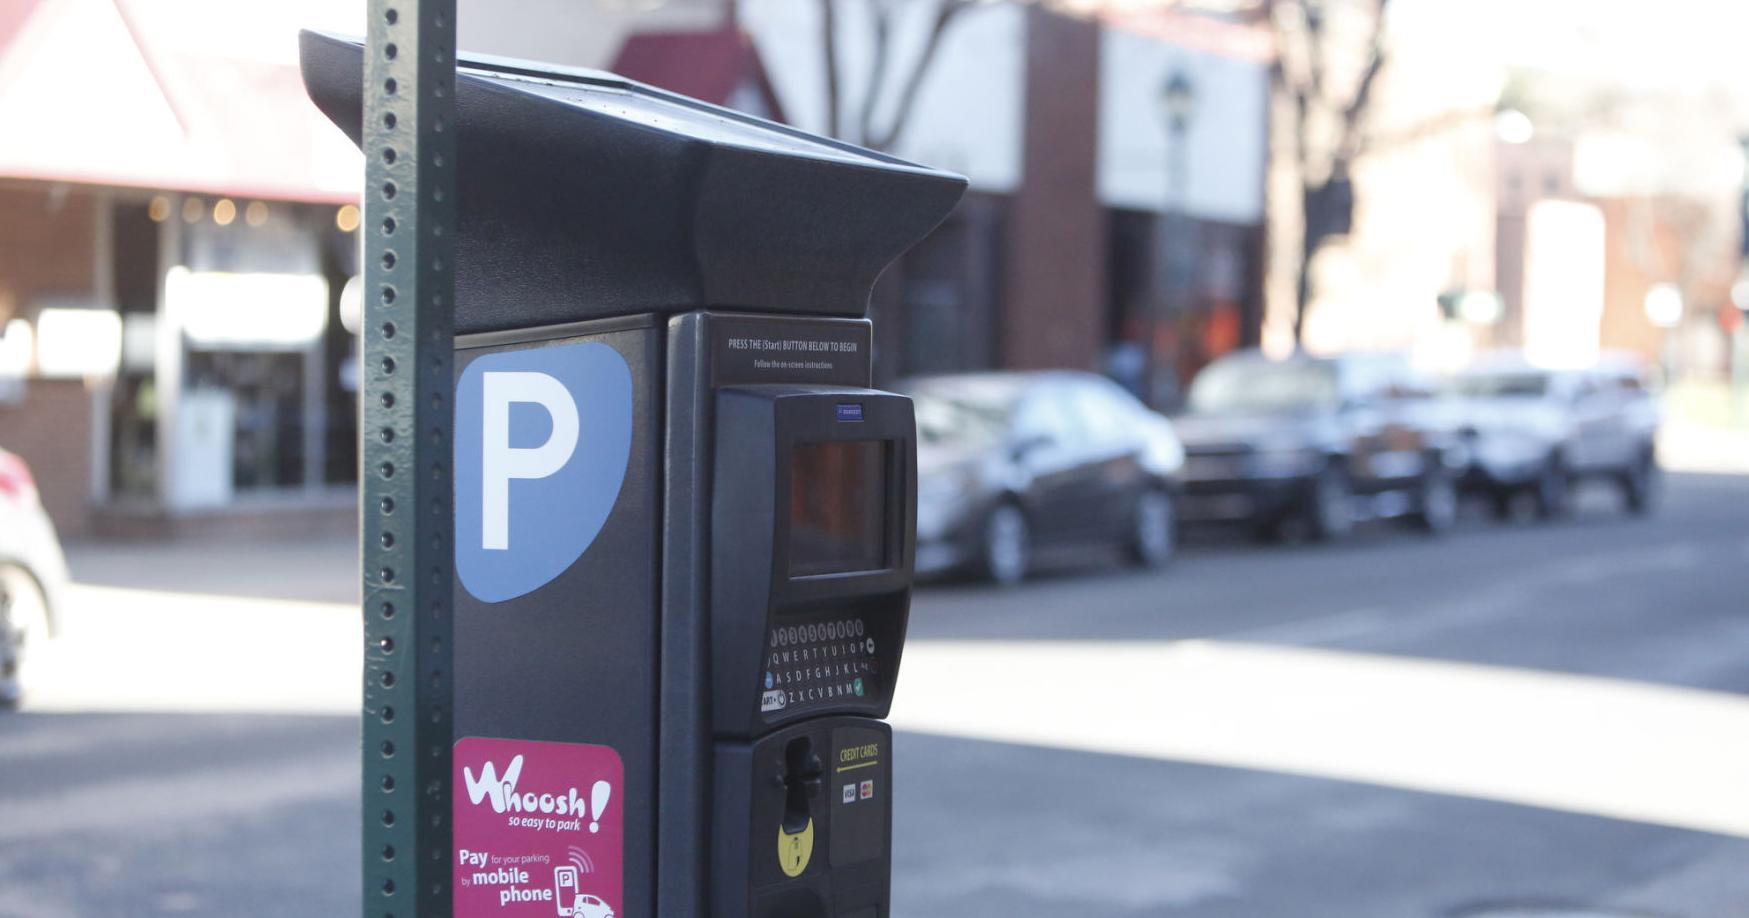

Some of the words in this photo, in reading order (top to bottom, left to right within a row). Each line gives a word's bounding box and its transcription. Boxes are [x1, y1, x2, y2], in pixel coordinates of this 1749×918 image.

[728, 338, 748, 350] PRESS
[749, 339, 761, 350] THE
[782, 340, 808, 351] BUTTON
[808, 341, 830, 352] BELOW
[830, 341, 839, 352] TO
[839, 342, 857, 353] BEGIN
[754, 359, 771, 369] Follow
[771, 359, 780, 369] the
[804, 359, 833, 370] instructions
[482, 371, 580, 550] P
[772, 652, 780, 665] Q
[783, 651, 790, 663] W
[793, 650, 799, 662] E
[803, 648, 809, 660] R
[813, 647, 818, 659] T
[822, 646, 828, 657] Y
[832, 646, 838, 657] U
[776, 673, 782, 685] A
[786, 671, 792, 683] S
[796, 670, 802, 682] D
[806, 669, 811, 680] F
[815, 667, 821, 679] G
[825, 666, 831, 678] H
[844, 663, 850, 675] K
[853, 662, 859, 673] L
[788, 692, 795, 703] Z
[798, 691, 804, 702] X
[808, 688, 814, 700] C
[817, 687, 823, 699] V
[827, 686, 833, 698] B
[836, 685, 843, 696] N
[845, 683, 853, 695] M
[840, 747, 860, 762] CREDIT
[860, 744, 878, 758] CARDS
[463, 754, 612, 833] Whoosh!
[508, 816, 520, 826] so
[521, 816, 544, 832] easy
[545, 818, 556, 829] to
[556, 818, 581, 832] park
[459, 849, 488, 868] Pay
[491, 854, 501, 864] for
[502, 857, 521, 866] your
[521, 854, 550, 866] parking
[461, 877, 471, 887] by
[472, 867, 529, 885] mobile
[500, 885, 552, 907] phone
